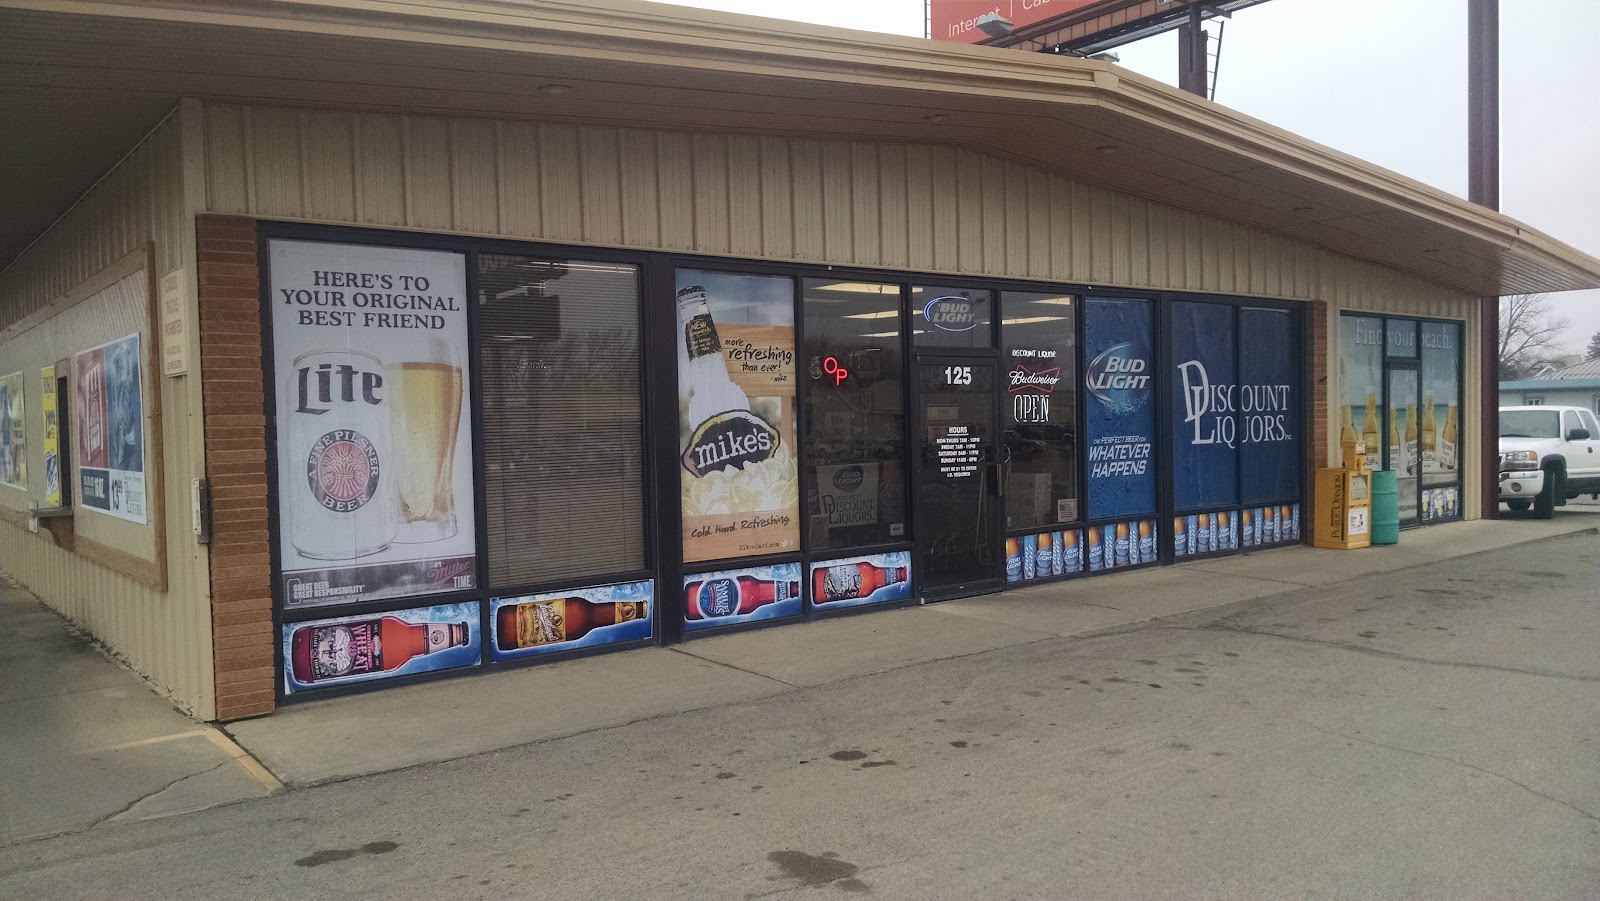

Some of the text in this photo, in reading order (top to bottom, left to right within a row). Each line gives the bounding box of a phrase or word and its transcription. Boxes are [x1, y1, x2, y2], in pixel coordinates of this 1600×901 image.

[1022, 0, 1050, 10] Ca
[948, 6, 1000, 37] Intert
[313, 270, 430, 292] HERE'S TO
[280, 288, 460, 312] YOUR ORIGINAL
[940, 302, 970, 312] BUD
[298, 310, 446, 330] BEST FRIEND
[692, 320, 707, 331] NEW
[932, 312, 976, 323] LIGHT
[724, 338, 744, 346] more
[1386, 330, 1415, 354] your
[1421, 325, 1452, 349] each.
[729, 344, 792, 365] refreshing
[1012, 349, 1056, 358] DISCOUNT LIQUOR
[742, 360, 782, 372] than ever!
[1104, 356, 1146, 374] BUD
[944, 366, 972, 385] 125
[1008, 370, 1060, 385] Budweiser
[1096, 373, 1150, 390] LIGHT
[295, 363, 383, 416] Lite
[1178, 360, 1290, 422] DISCOUNT
[1014, 394, 1050, 422] OPEN
[1191, 386, 1285, 449] LIQUORS
[308, 431, 379, 480] A FINE PILSNER
[695, 428, 771, 468] mike's
[1089, 443, 1151, 462] WHATEVER
[1092, 460, 1147, 478] HAPPENS
[1332, 474, 1342, 510] OPINION
[322, 494, 370, 511] BEER
[821, 494, 874, 516] DISCOUNT
[827, 503, 872, 525] LIQUORS
[691, 515, 790, 538] Cold. Hard. Refreshing.
[428, 562, 470, 582] Miller
[1006, 562, 1021, 570] LIGHT
[293, 582, 330, 592] GREAT BEER
[294, 590, 314, 600] GREAT
[714, 583, 722, 614] ADAMS
[720, 580, 730, 615] SAMUEL
[352, 624, 368, 670] WHEAT
